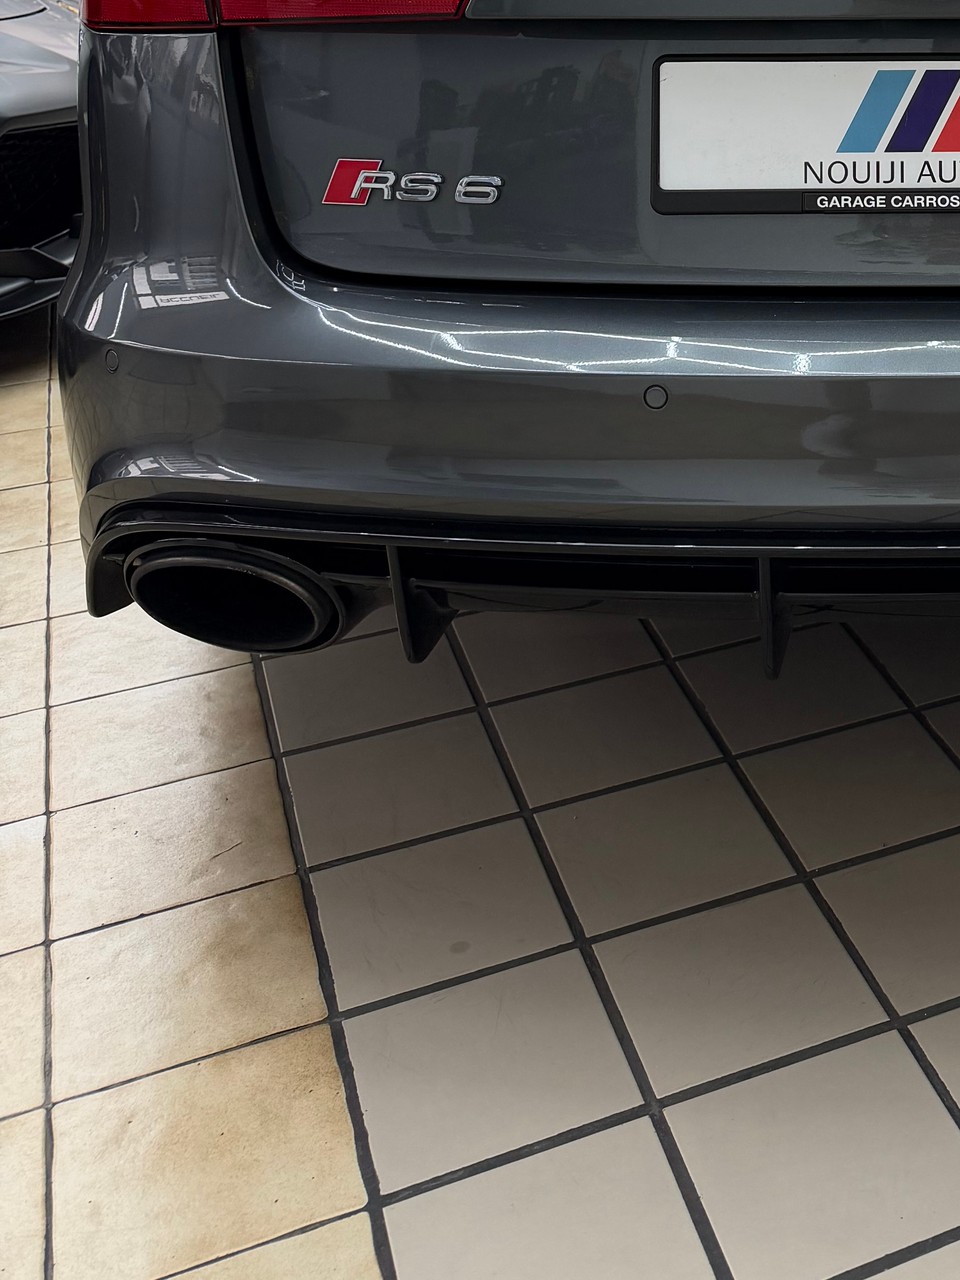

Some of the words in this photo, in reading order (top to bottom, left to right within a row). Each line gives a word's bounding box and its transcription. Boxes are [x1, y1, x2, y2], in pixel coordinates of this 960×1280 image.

[803, 160, 905, 184] NOUIJI
[454, 174, 503, 205] 6
[816, 195, 887, 208] GARAGE
